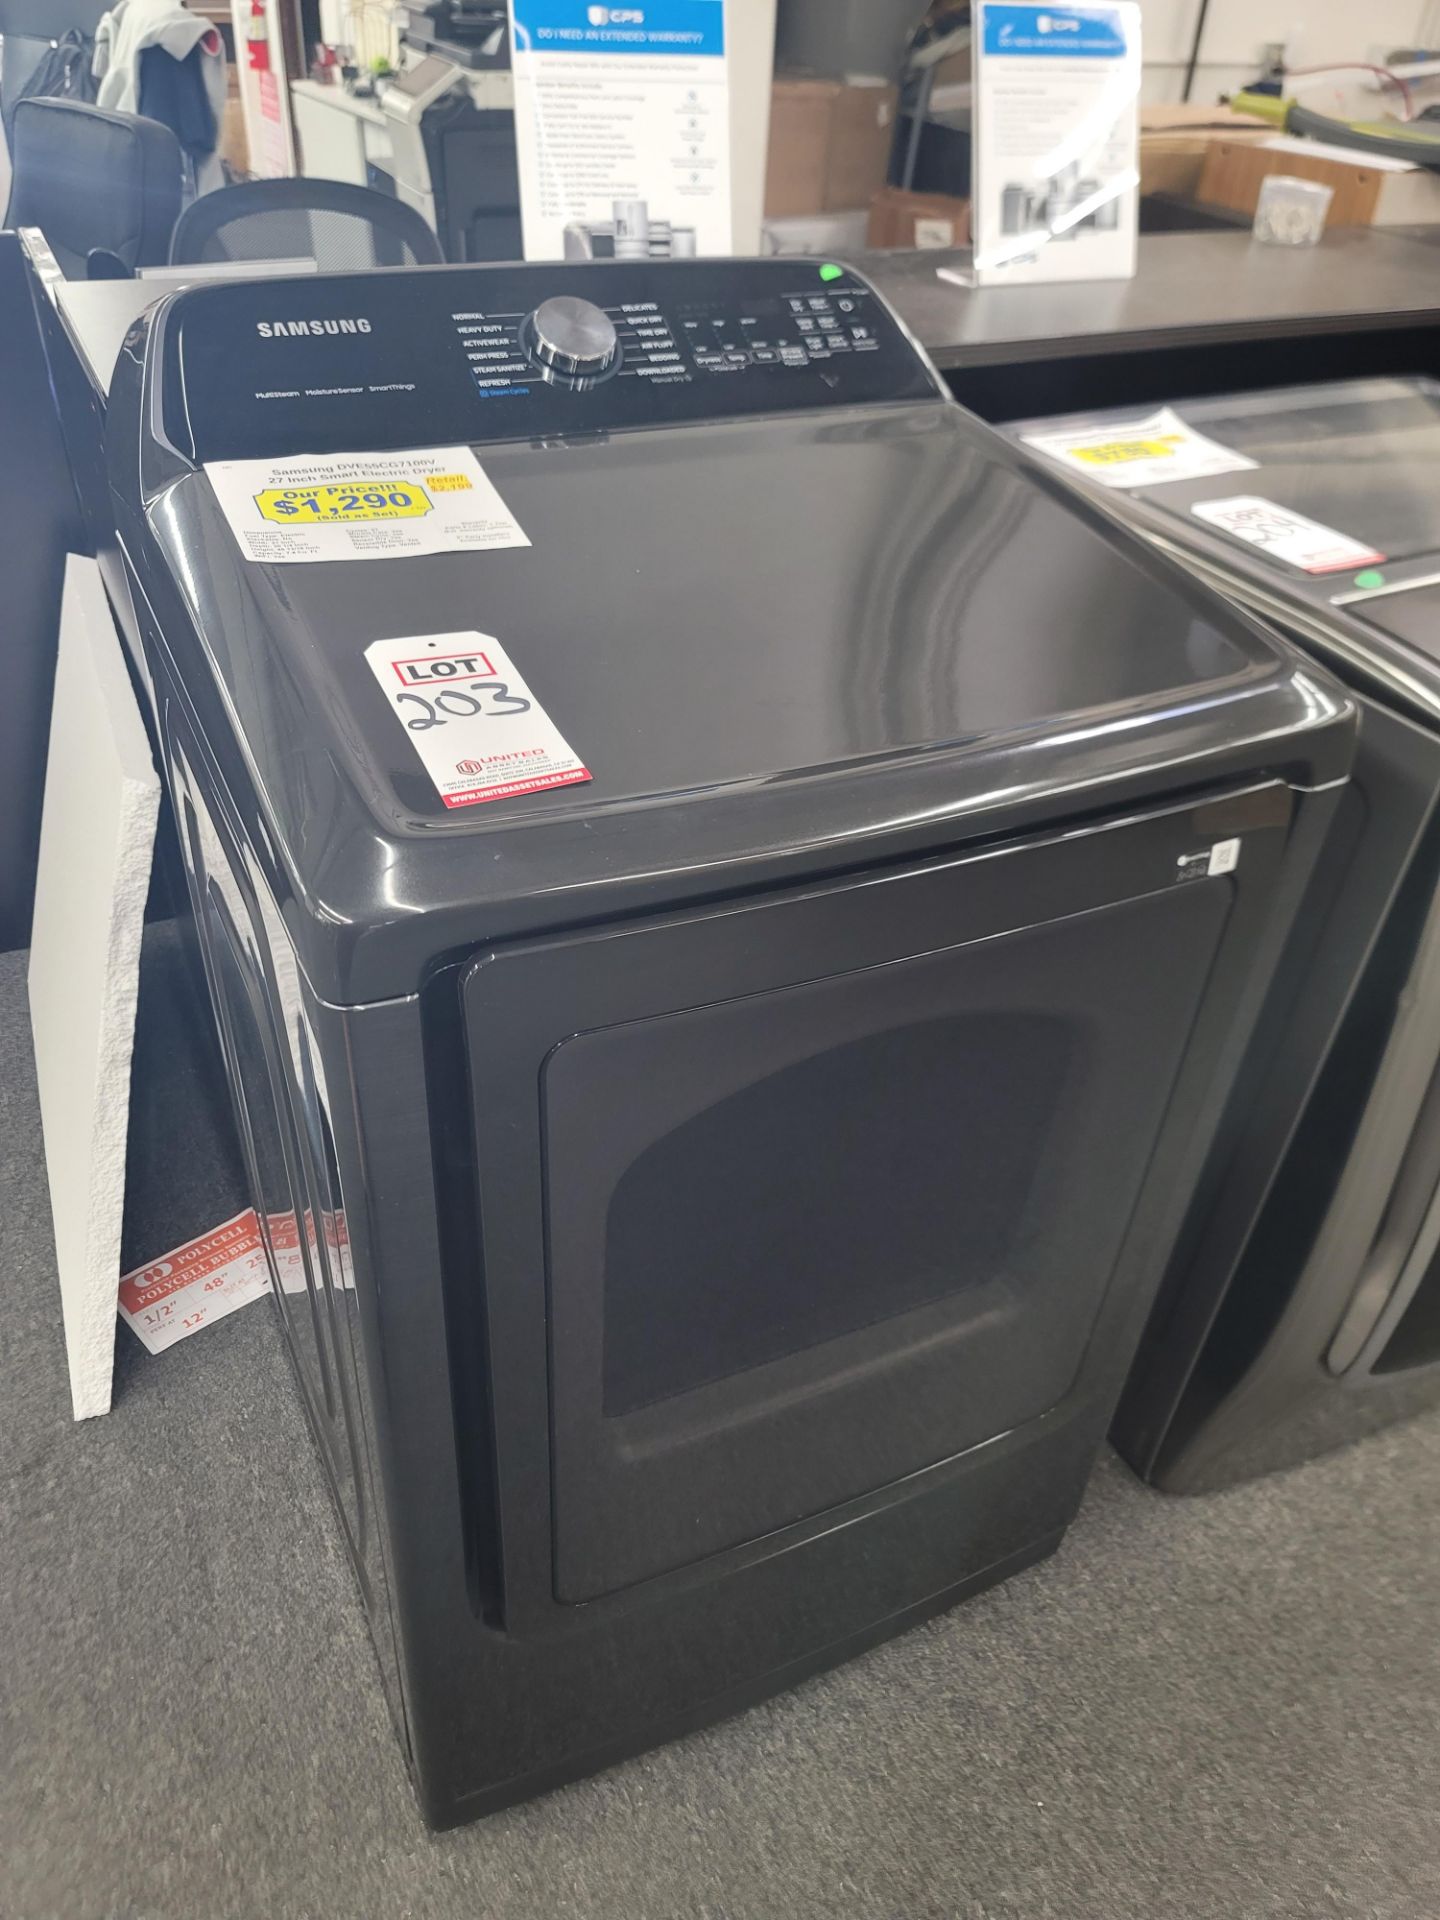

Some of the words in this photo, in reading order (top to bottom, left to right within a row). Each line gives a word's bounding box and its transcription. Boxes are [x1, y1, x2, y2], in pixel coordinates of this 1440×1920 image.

[537, 28, 553, 40] DO
[559, 29, 584, 41] NEED
[585, 30, 599, 41] AN
[600, 30, 647, 42] EXTENDED
[648, 31, 704, 45] WARRANTY?
[452, 312, 485, 320] NORMAL
[256, 318, 372, 338] SAMSUNG
[457, 326, 482, 334] HEAVY
[483, 325, 502, 333] DUTY
[463, 338, 510, 347] ACTIVEWEAR
[478, 378, 511, 388] REFRESH
[272, 467, 334, 476] Samsung
[286, 475, 317, 483] Inch
[320, 471, 358, 480] Smart
[361, 469, 410, 478] Electric
[412, 466, 446, 475] Dryer
[283, 490, 320, 499] Our
[326, 484, 398, 496] Price!!!
[273, 493, 412, 516] $1,290
[406, 658, 478, 681] LOT
[396, 682, 531, 731] 203
[480, 748, 545, 764] UNITED
[449, 770, 585, 804] WWW.UNITEDASSETSALES.COM
[177, 1225, 248, 1265] POLYCELL
[137, 1262, 210, 1304] POLYCELL
[203, 1273, 228, 1292] 48"
[144, 1300, 177, 1326] 1/2"
[182, 1307, 207, 1329] 12"
